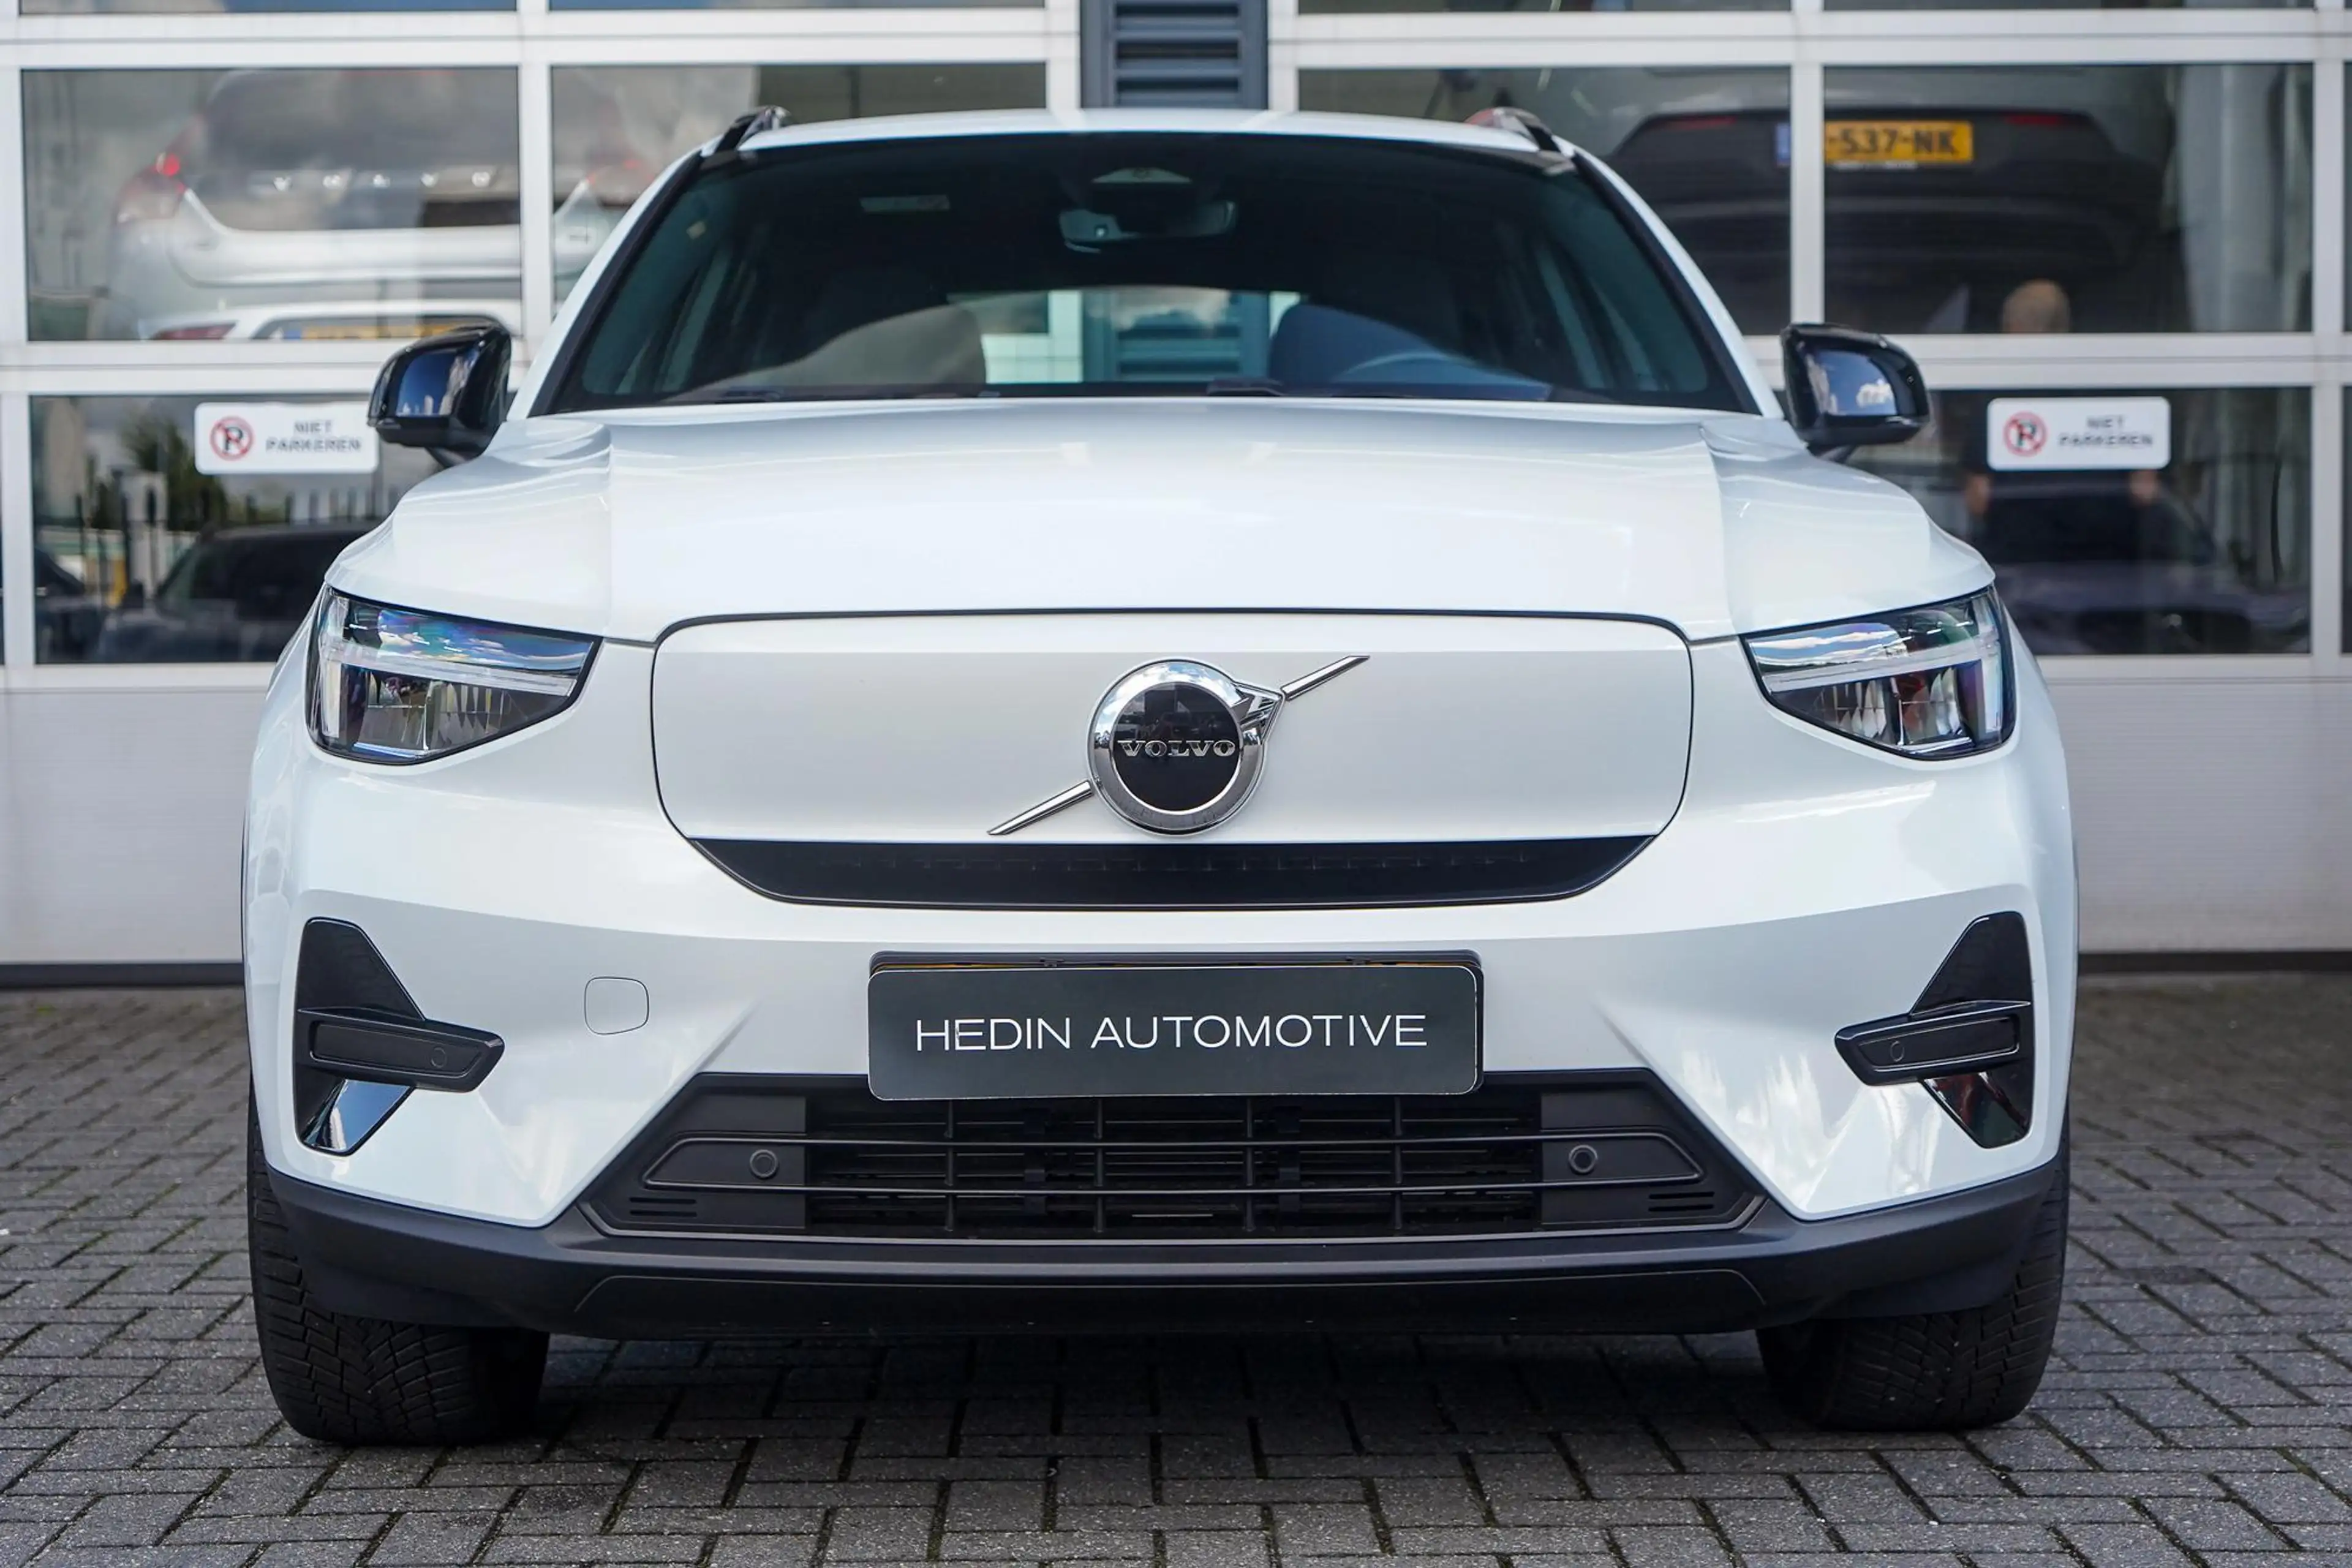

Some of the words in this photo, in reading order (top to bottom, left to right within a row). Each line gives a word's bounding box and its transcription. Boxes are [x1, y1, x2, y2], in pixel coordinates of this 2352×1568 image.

[1826, 128, 1959, 155] -537-NK
[294, 420, 333, 433] NIET
[265, 438, 361, 452] PARKEREN
[1117, 740, 1235, 757] VOLVO
[916, 1018, 1071, 1051] HEDIN
[1090, 1014, 1428, 1049] AUTOMOTIVE
